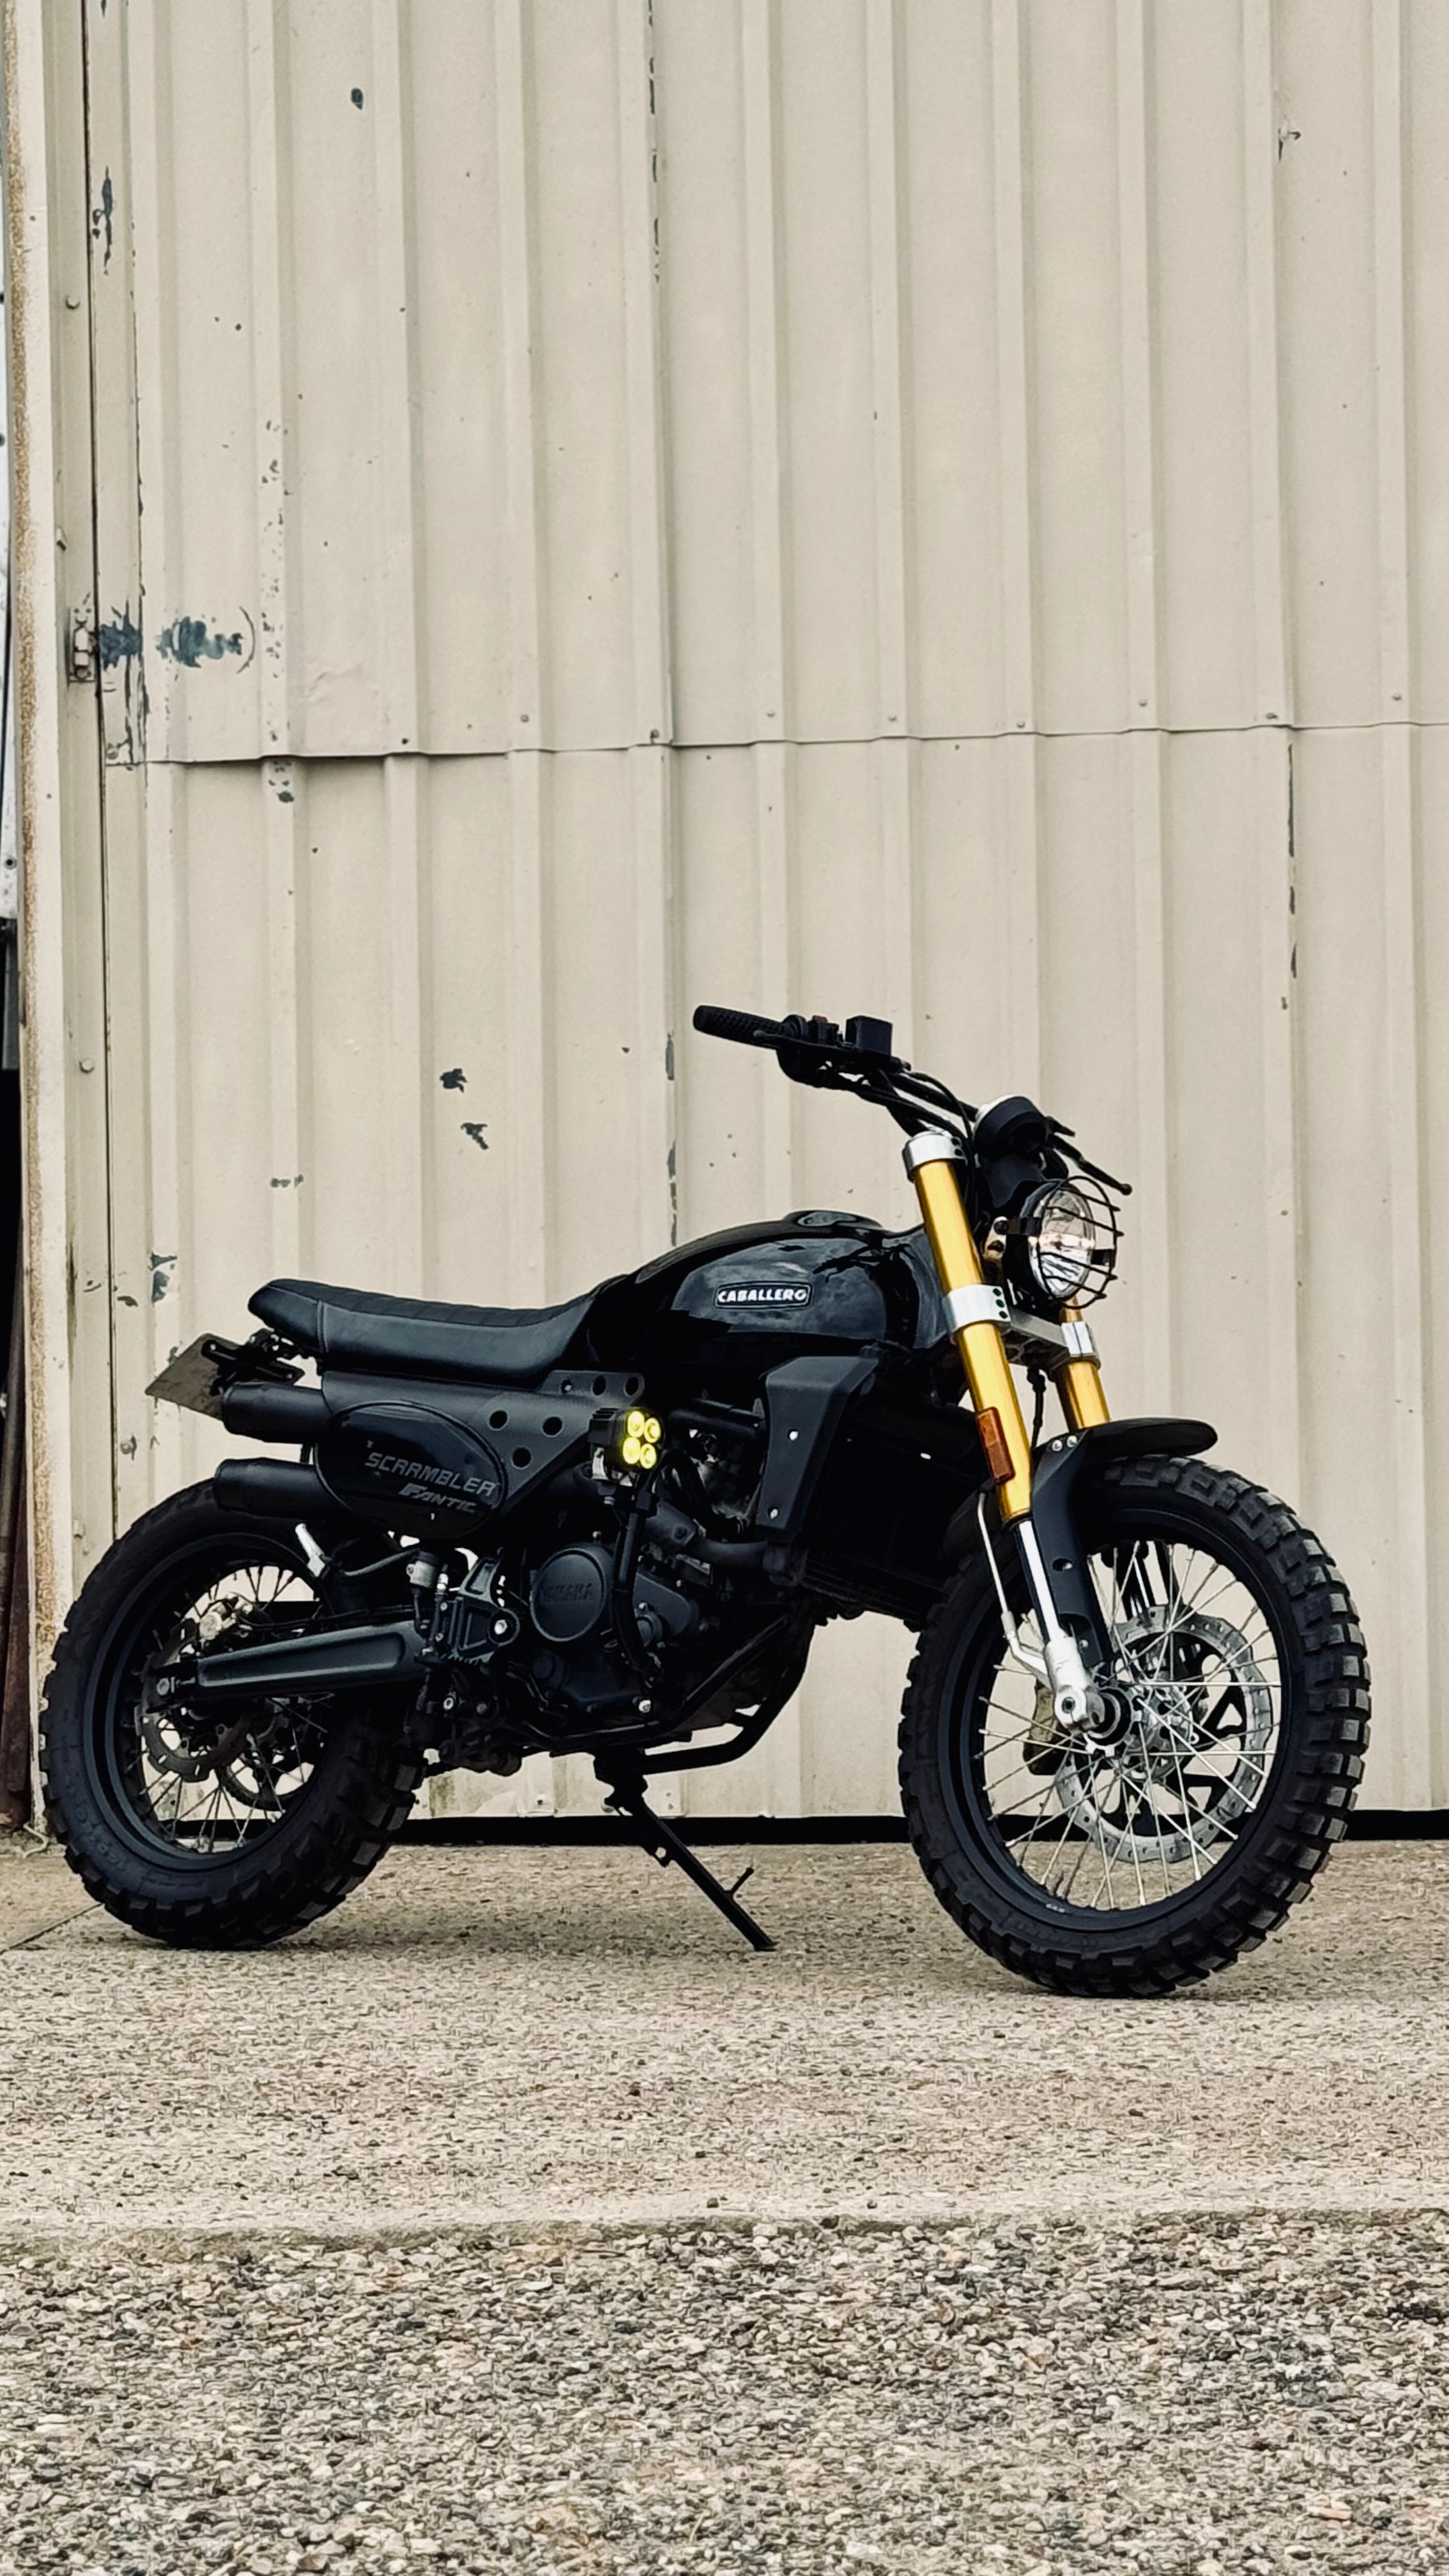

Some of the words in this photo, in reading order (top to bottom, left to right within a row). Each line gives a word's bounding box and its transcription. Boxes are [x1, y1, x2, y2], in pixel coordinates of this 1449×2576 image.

[717, 1288, 807, 1303] CABALLERO
[364, 1452, 498, 1496] SCRAMBLER
[397, 1482, 478, 1514] FANTIC
